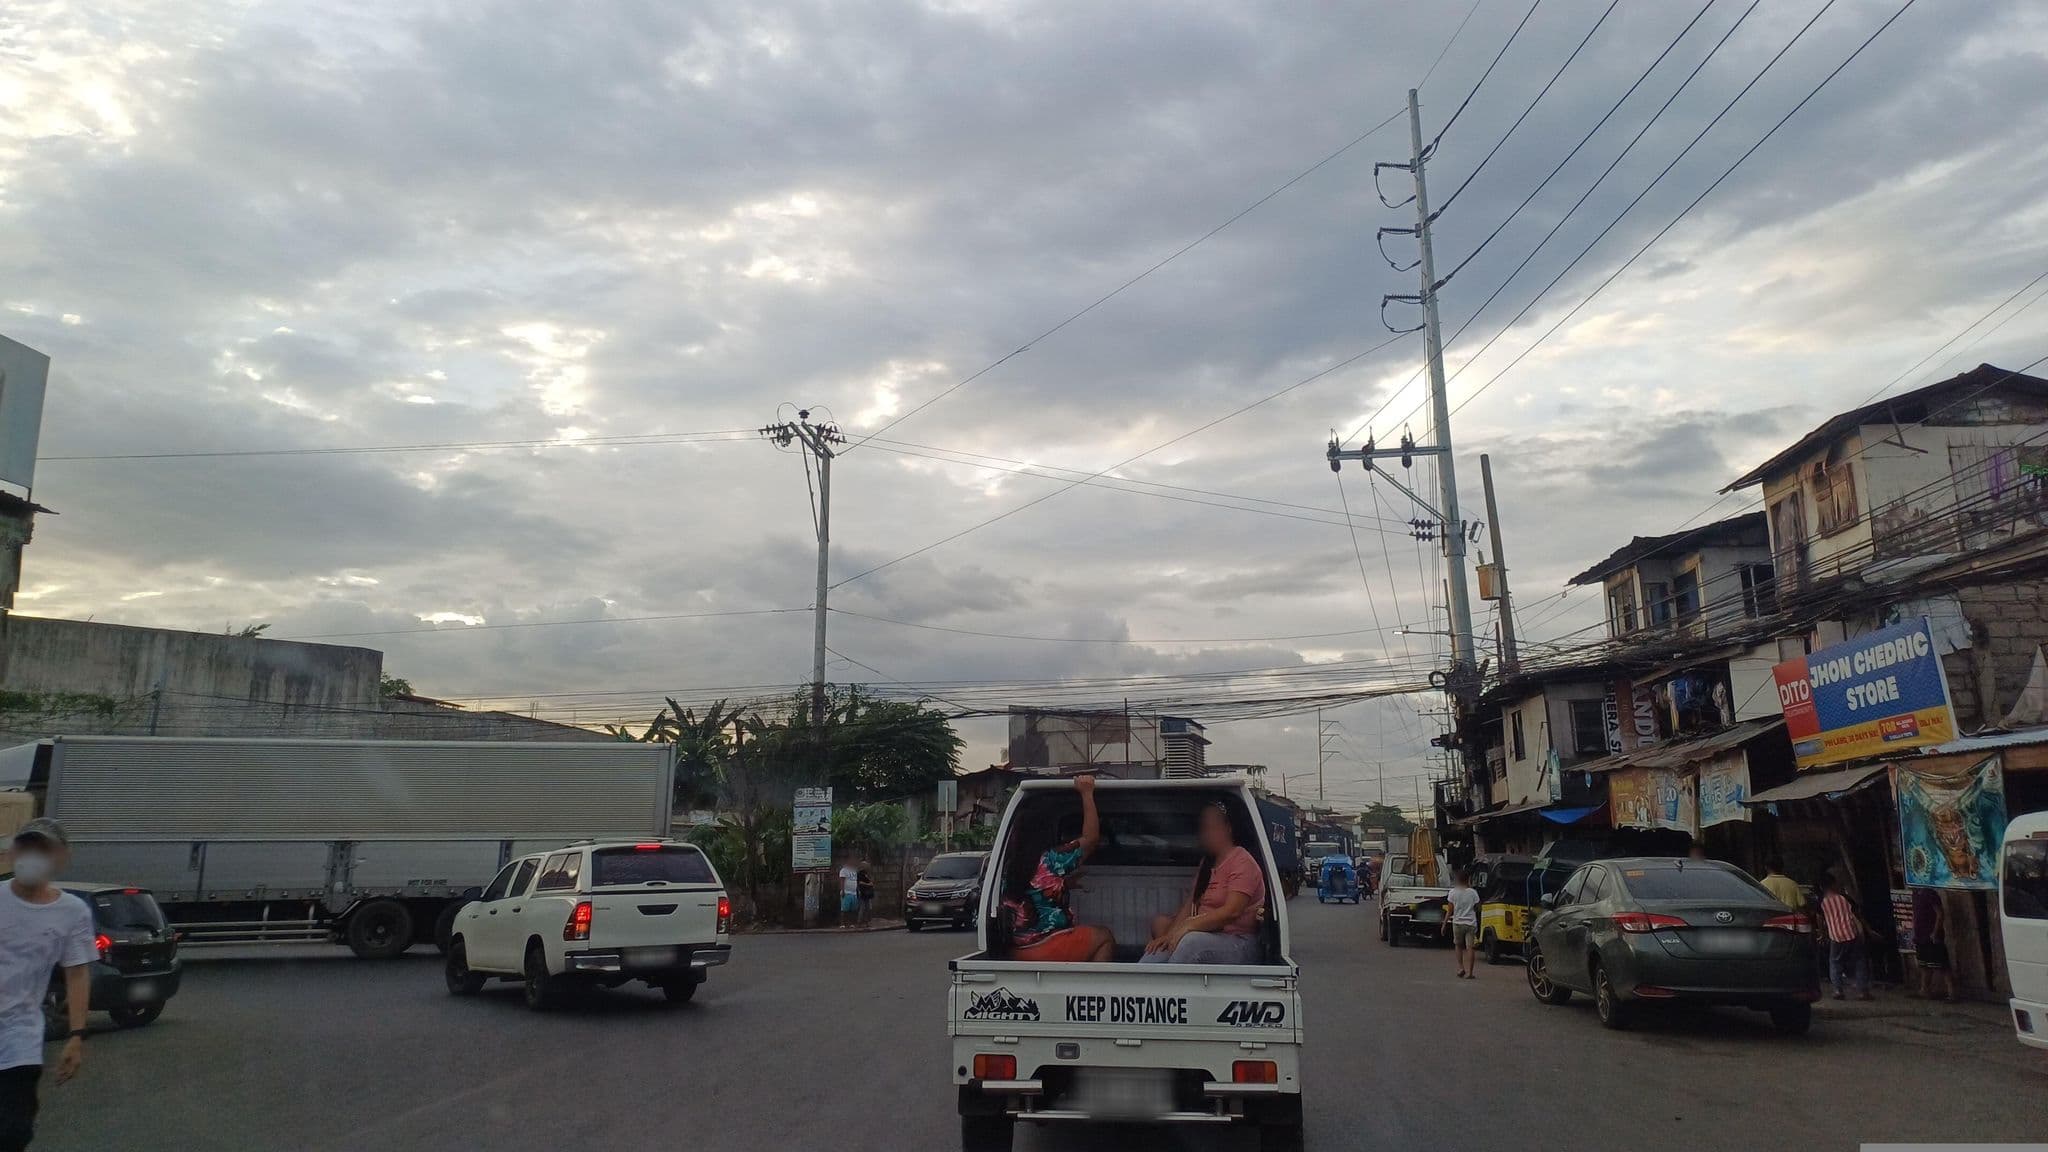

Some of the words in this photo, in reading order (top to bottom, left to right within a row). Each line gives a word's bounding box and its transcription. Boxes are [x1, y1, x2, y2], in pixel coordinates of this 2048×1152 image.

[1810, 656, 1852, 688] JHON
[1853, 631, 1928, 675] CHEDRIC
[1780, 679, 1809, 705] DITO
[1846, 675, 1900, 711] STORE
[965, 1010, 1040, 1021] MIGHTY
[1065, 996, 1106, 1021] KEEP
[1110, 997, 1188, 1024] DISTANCE
[1216, 1001, 1285, 1026] 4WD
